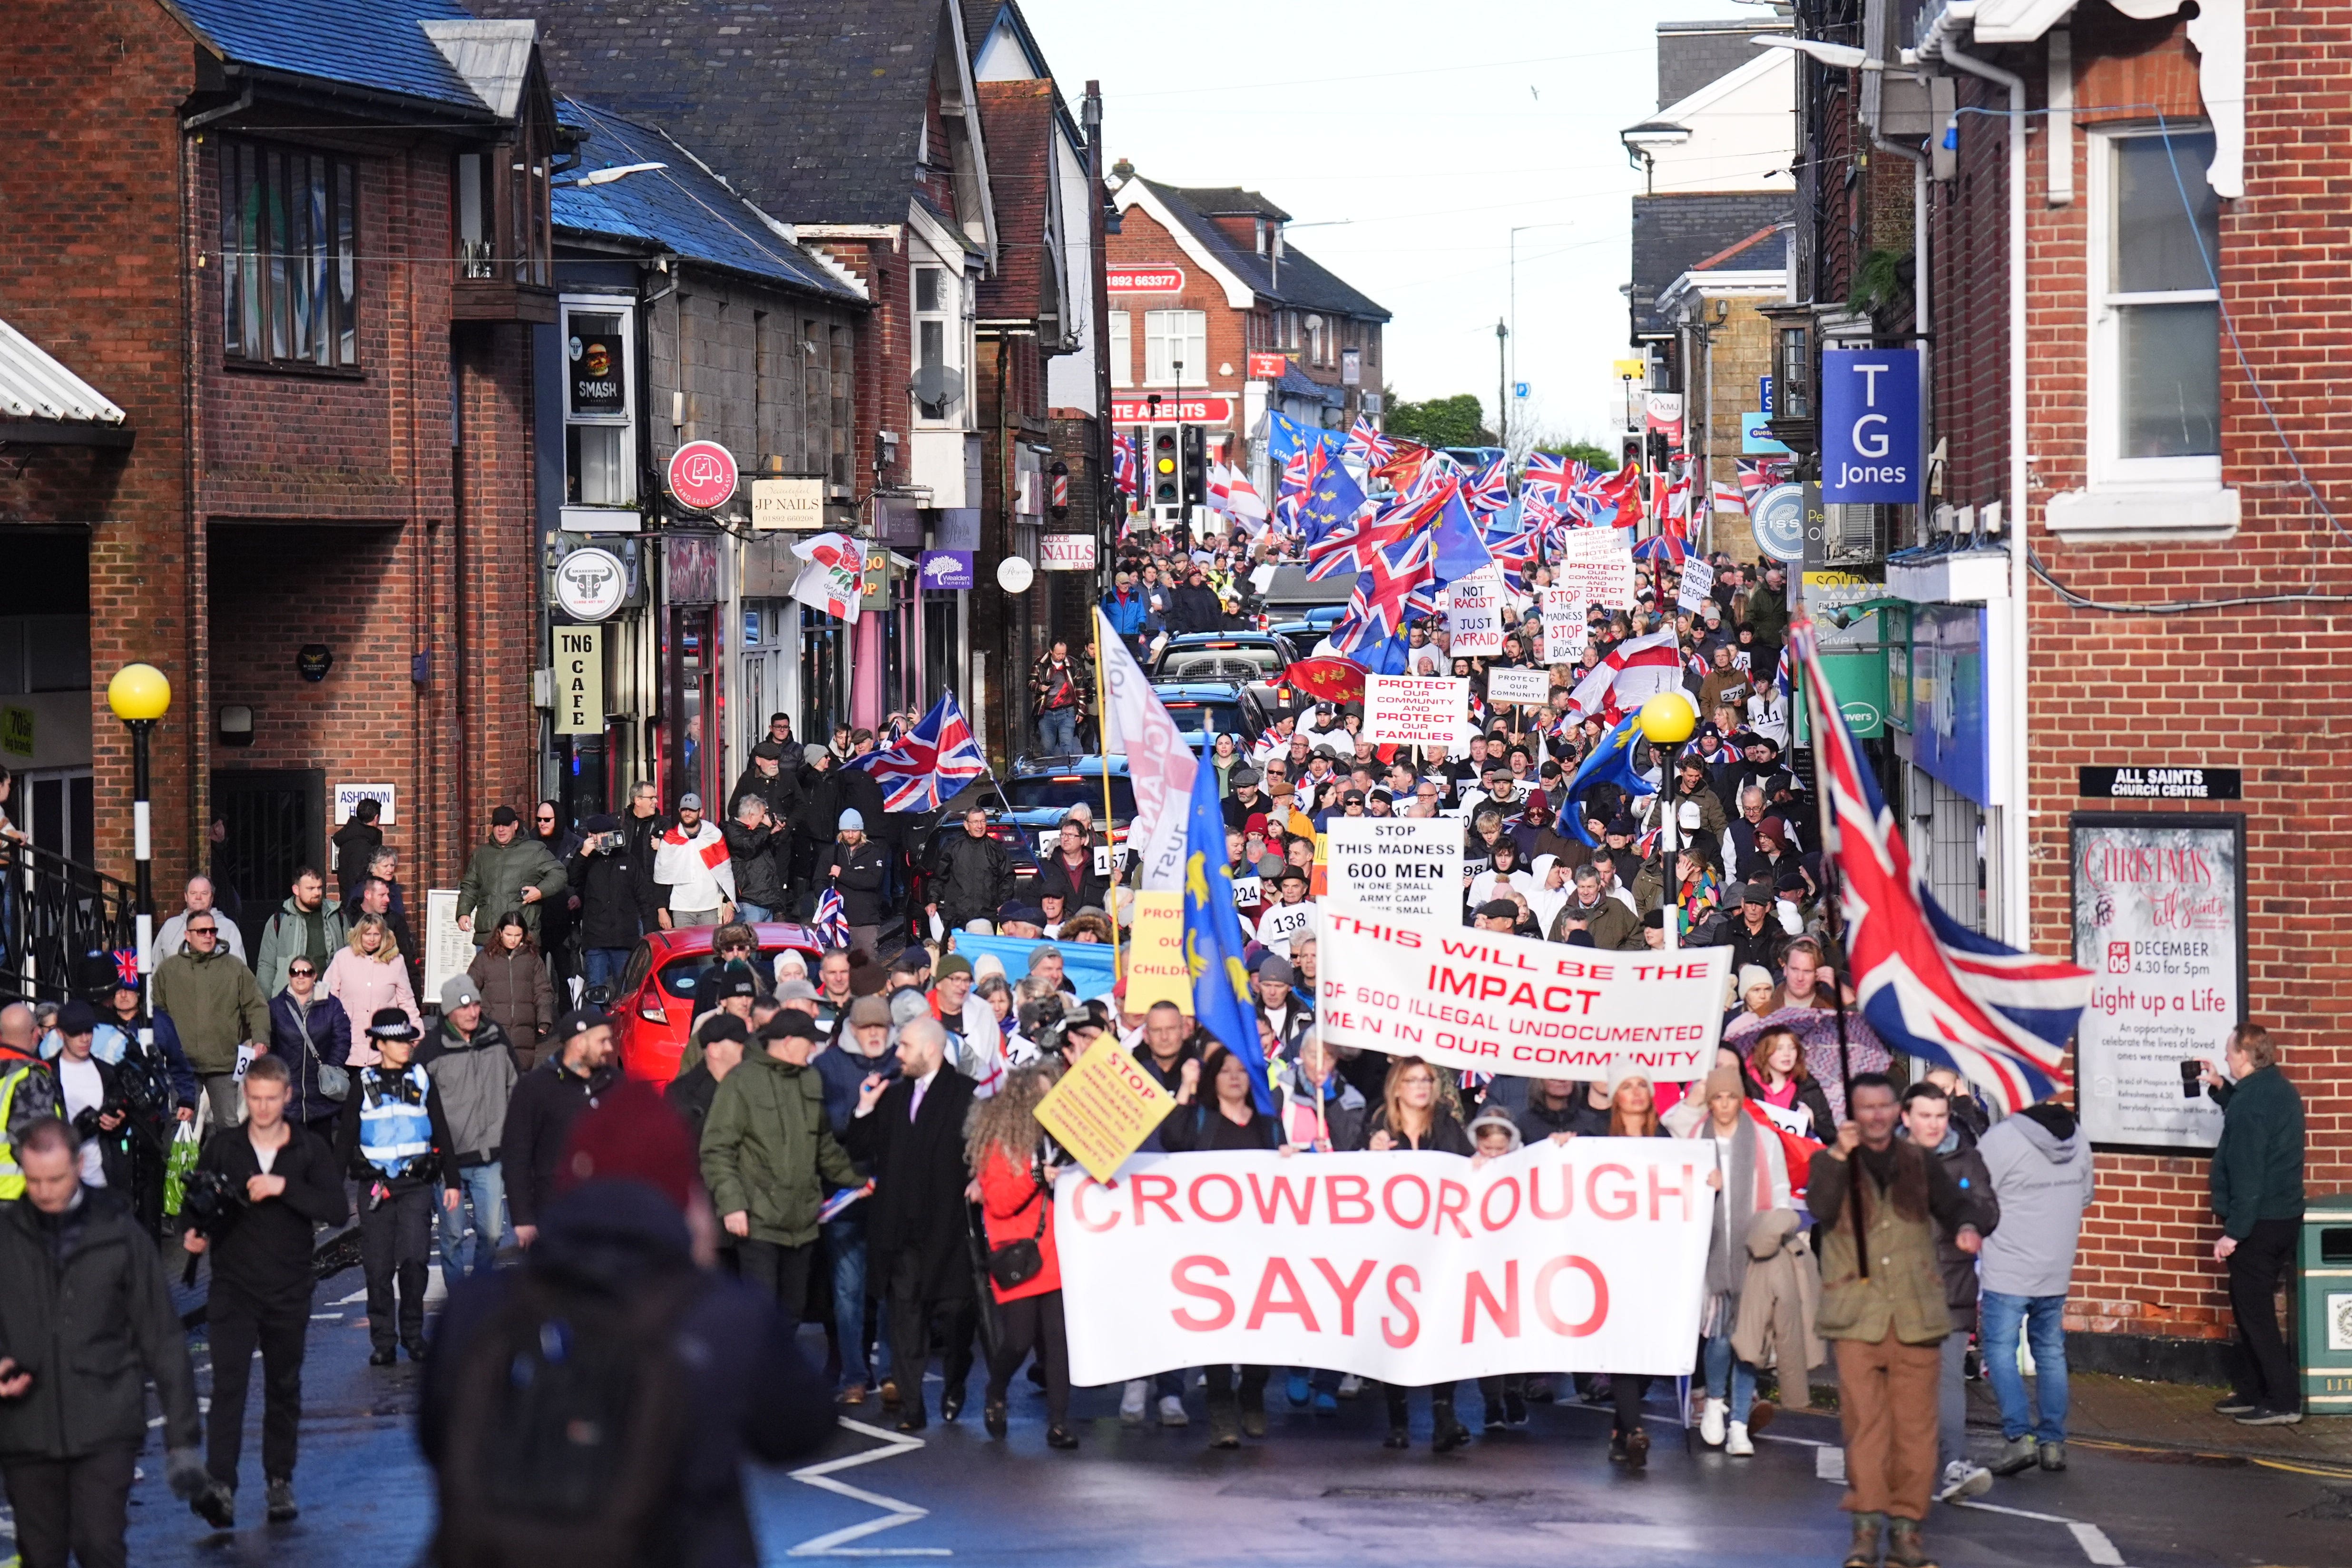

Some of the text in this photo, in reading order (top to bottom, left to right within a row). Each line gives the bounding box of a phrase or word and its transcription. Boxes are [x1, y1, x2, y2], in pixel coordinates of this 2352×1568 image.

[1135, 275, 1176, 286] 663377
[579, 381, 617, 398] SMASH
[1853, 364, 1889, 407] T
[1112, 403, 1206, 418] TE AGENTS
[1852, 414, 1889, 458] G
[1835, 465, 1906, 490] Jones
[678, 488, 691, 500] AND
[710, 492, 724, 503] FOR
[722, 474, 731, 492] CASH
[755, 498, 819, 510] JP NAILS
[1528, 500, 1553, 518] STOP THE
[1757, 519, 1801, 530] FISS
[1573, 528, 1621, 537] PROTECT
[1574, 538, 1622, 547] COMMUNITY
[1040, 545, 1094, 560] NAILS
[1575, 548, 1623, 557] PROTECT
[1072, 562, 1094, 570] BAR
[1687, 560, 1711, 579] DETAIN
[1685, 572, 1710, 591] PROCESS
[1463, 586, 1485, 597] NOT
[1549, 590, 1580, 603] STOP
[1454, 597, 1495, 609] RACIST
[1546, 611, 1582, 621] MADNESS
[1460, 617, 1492, 630] JUST
[1551, 624, 1583, 639] STOP
[561, 635, 592, 653] TN6
[1452, 632, 1499, 647] AFRAID
[1553, 646, 1583, 657] BOATS
[1378, 679, 1457, 690] PROTECT
[1498, 675, 1541, 683] PROTECT
[571, 660, 585, 725] CAFE
[1722, 688, 1745, 702] 279
[1377, 697, 1455, 705] COMMUNITY
[1376, 713, 1455, 723] PROTECT
[1757, 712, 1781, 725] 211
[1376, 730, 1453, 741] FAMILIES
[2115, 769, 2204, 785] ALL SAINTS
[341, 791, 390, 803] ASHDOWN
[2111, 784, 2208, 797] CHURCH CENTRE
[1375, 826, 1416, 836] STOP
[1336, 844, 1372, 854] THIS
[1379, 844, 1455, 855] MADNESS
[1348, 863, 1443, 878] 600 MEN
[1369, 882, 1392, 890] ONE
[1396, 882, 1433, 891] SMALL
[1360, 894, 1427, 903] ARMY CAMP
[1143, 908, 1184, 919] PROT
[1274, 912, 1306, 934] 138
[1159, 938, 1182, 947] OU
[1329, 914, 1709, 981] THIS WILL BE THE
[2111, 941, 2209, 957] SAT DECEMBER
[1134, 964, 1190, 976] CHILDR
[2109, 956, 2210, 978] 06 4.30 for 5pm
[1428, 964, 1601, 1015] IMPACT
[2091, 986, 2226, 1017] Light up a Life
[1357, 987, 1399, 1011] 600
[1409, 998, 1499, 1031] ILLEGAL
[1509, 1019, 1704, 1042] UNDOCUMENTED
[2119, 1023, 2195, 1037] An opportunity to
[1323, 1009, 1701, 1068] MEN IN OUR COMMNITY
[2102, 1036, 2215, 1049] celebrate the lives of loved
[1107, 1052, 1156, 1099] STOP
[1073, 1163, 1693, 1239] CROWBOROUGH
[1170, 1254, 1609, 1349] SAYS NO
[2327, 1378, 2352, 1392] LIT
